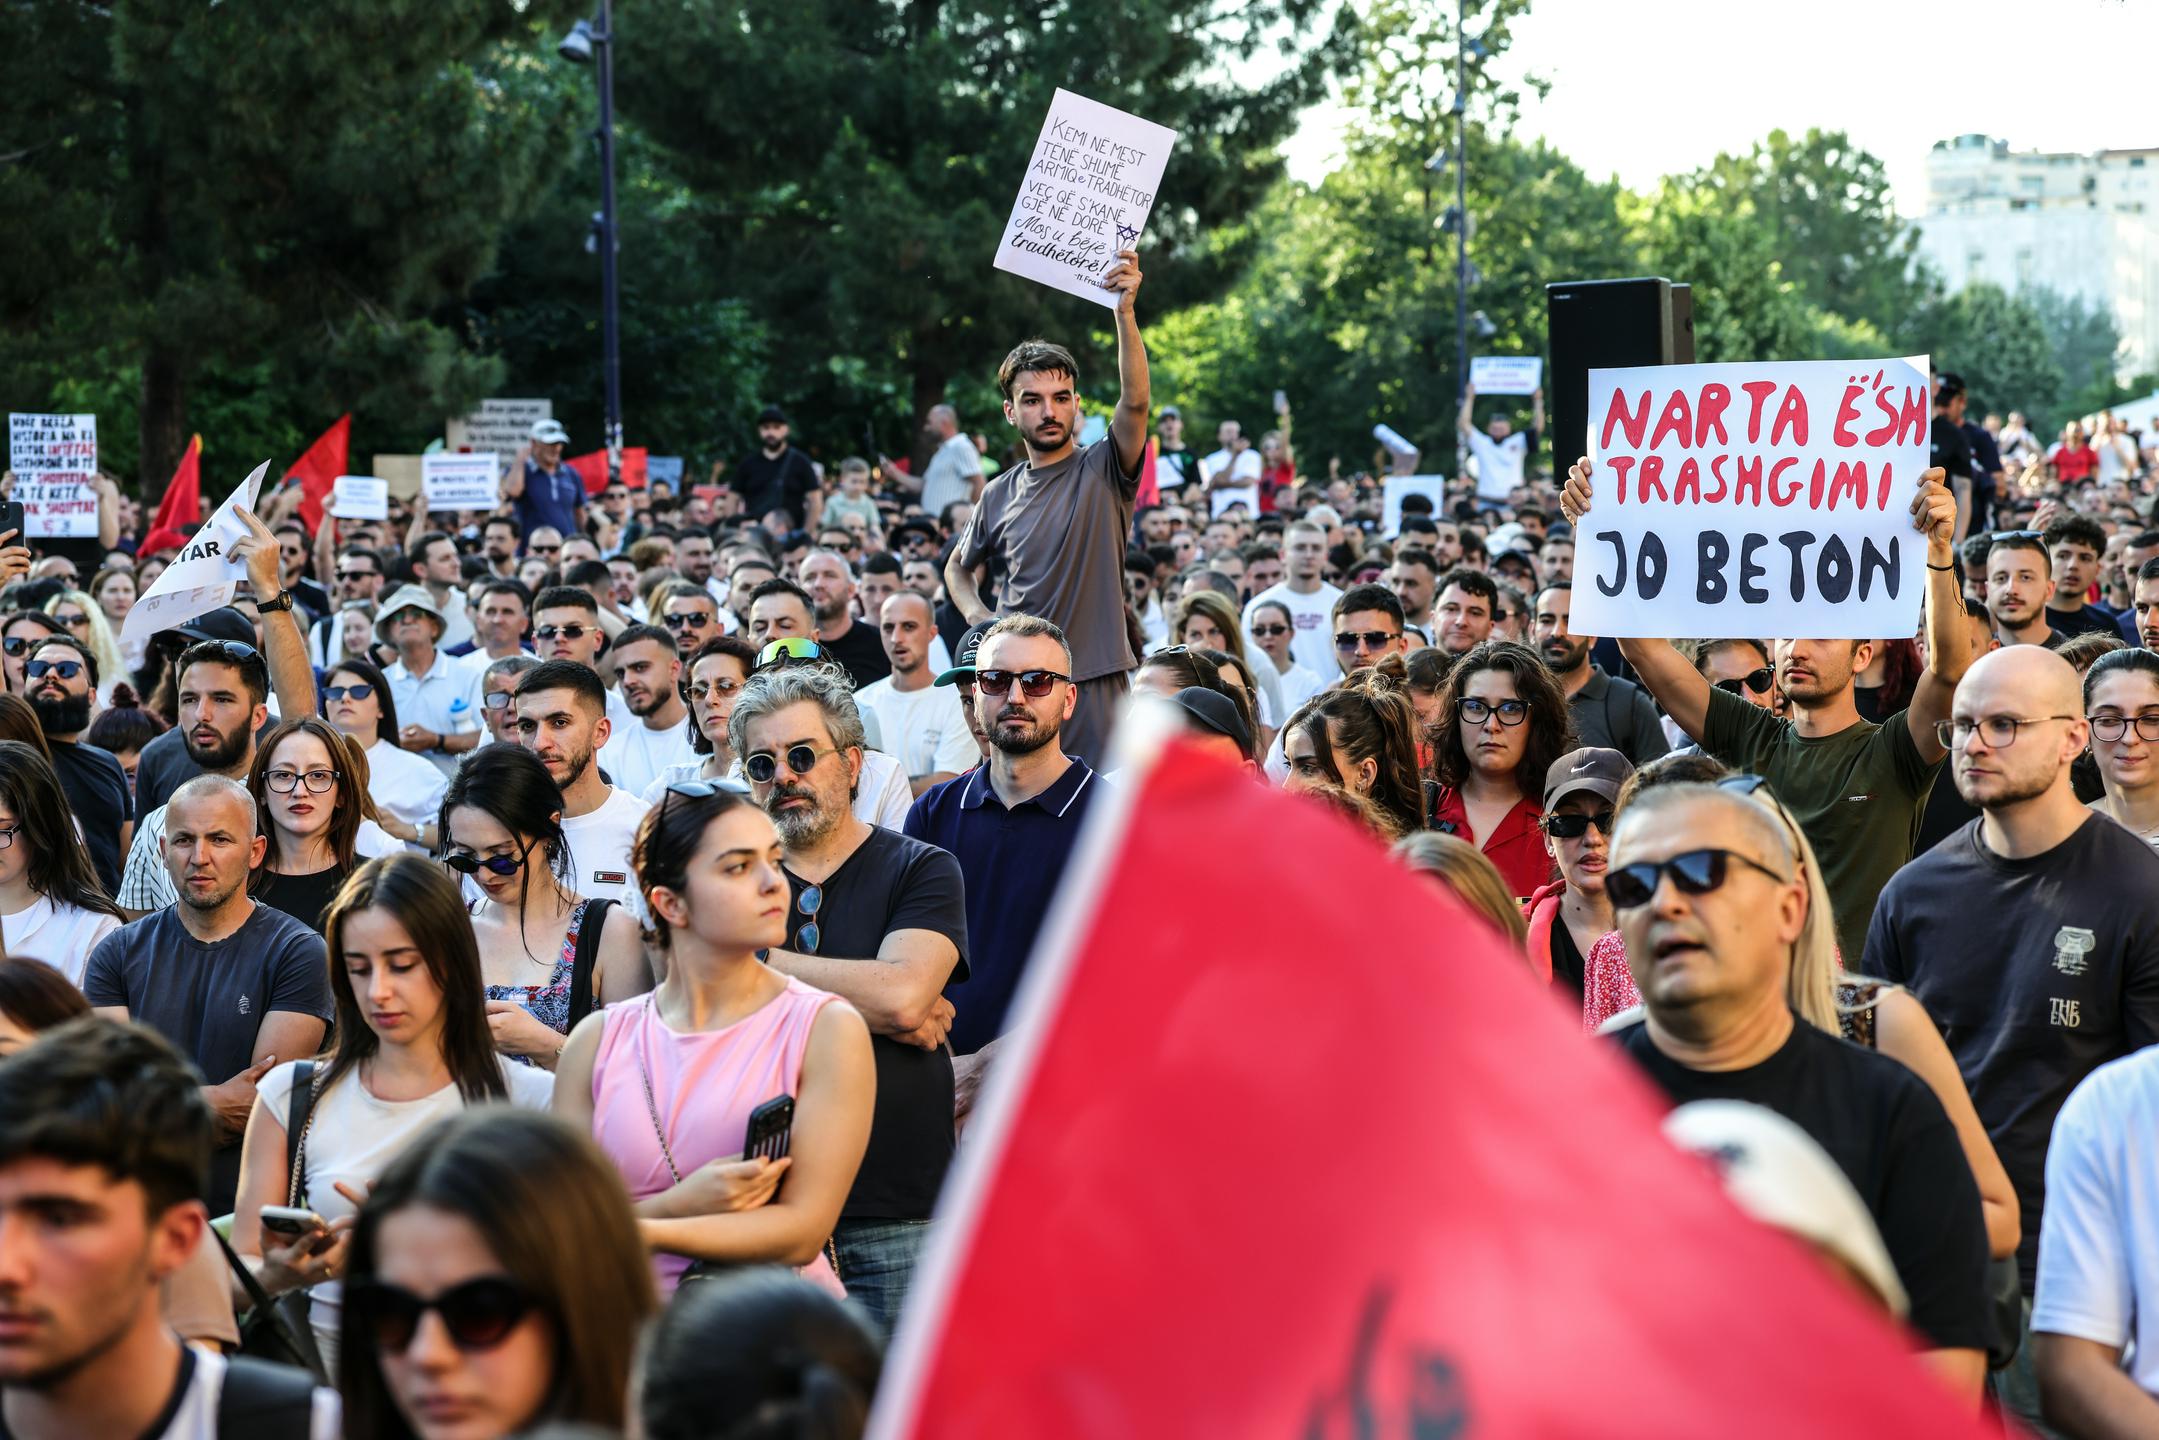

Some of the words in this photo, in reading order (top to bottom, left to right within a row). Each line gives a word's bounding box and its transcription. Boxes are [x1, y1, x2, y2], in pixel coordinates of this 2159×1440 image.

[1043, 140, 1079, 166] TËNË
[1080, 154, 1125, 181] SHUMË
[1051, 116, 1088, 146] KEMI
[1090, 136, 1110, 155] NË
[1110, 143, 1146, 166] MEST
[1029, 180, 1054, 201] VEÇ
[1057, 190, 1076, 206] QË
[1078, 197, 1126, 225] S'KANË
[1032, 159, 1077, 183] ARMIQ
[1088, 174, 1152, 209] TRADHËTOR
[1015, 216, 1051, 239] Mos
[1052, 230, 1065, 242] u
[1068, 230, 1107, 259] bëjë
[1021, 196, 1048, 214] GJË
[1048, 204, 1069, 222] NË
[1072, 211, 1109, 235] DORË
[1011, 232, 1110, 276] tradhëtorë!
[1601, 380, 1809, 450] NARTA
[1607, 454, 1893, 512] TRASHGIMI
[1596, 530, 1668, 601] JO
[1696, 530, 1900, 604] BETON
[2049, 997, 2080, 1015] THE
[2050, 1012, 2081, 1027] END
